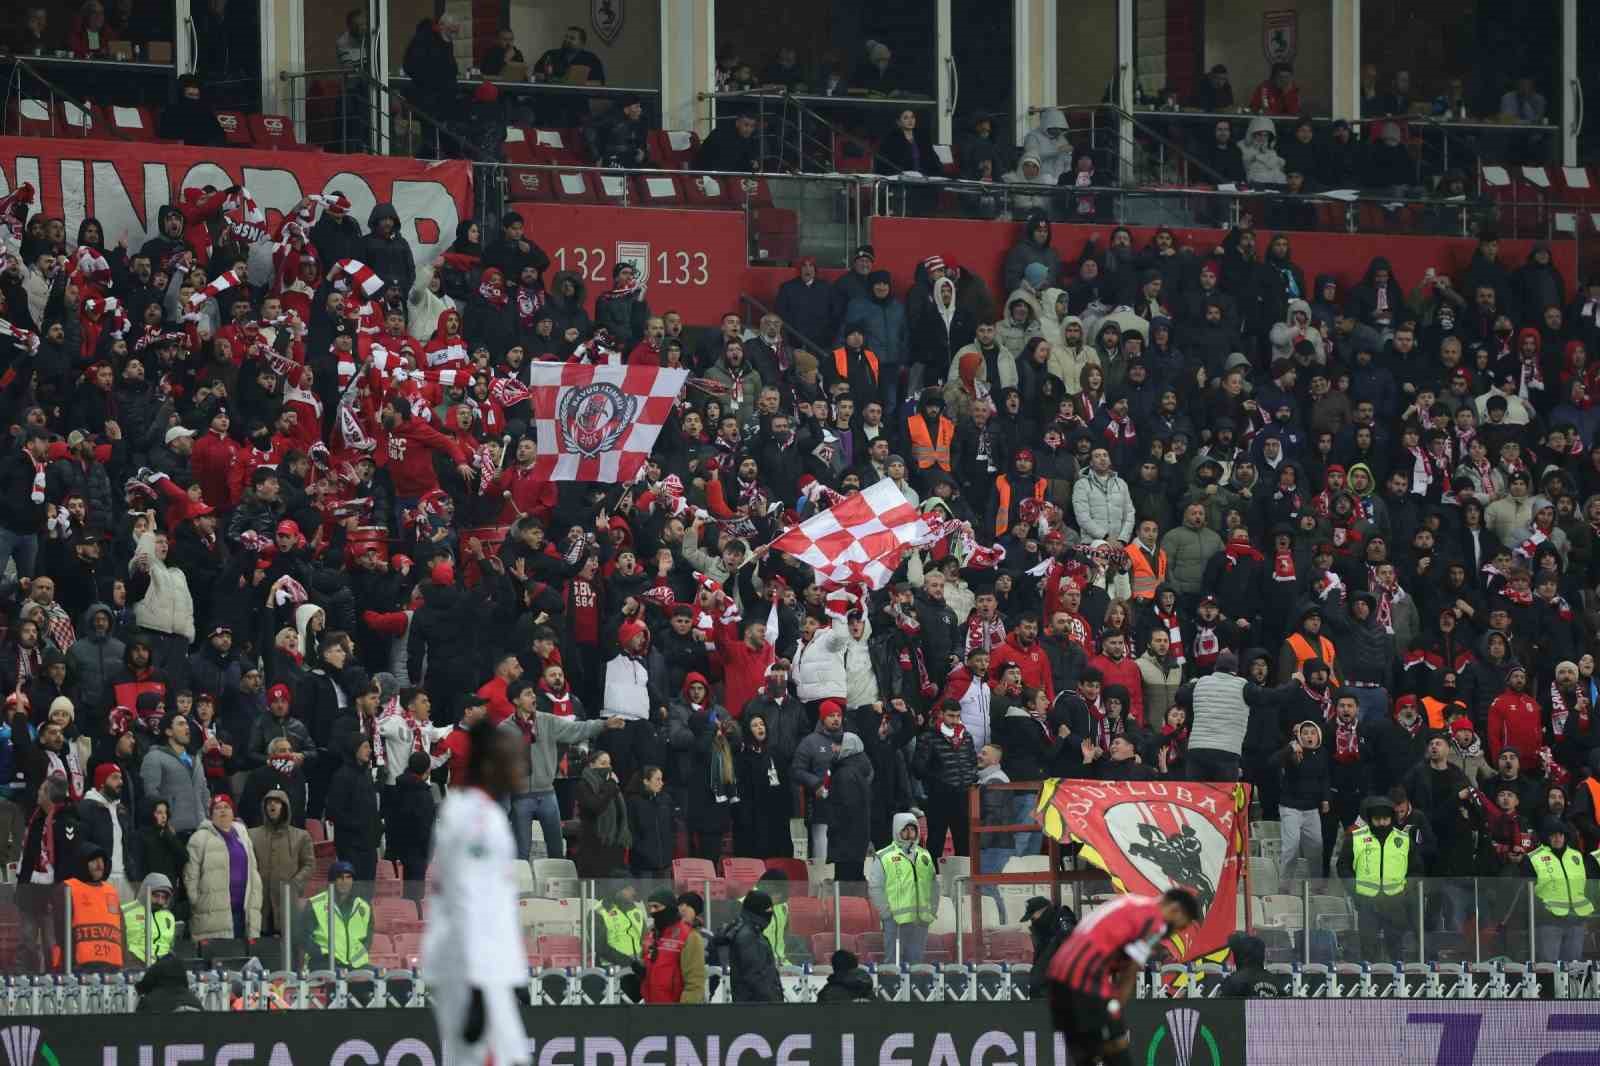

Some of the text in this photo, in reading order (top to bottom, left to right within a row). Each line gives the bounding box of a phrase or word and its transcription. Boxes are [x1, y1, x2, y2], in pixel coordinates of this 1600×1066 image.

[554, 248, 606, 281] 132
[657, 252, 709, 285] 133
[75, 925, 121, 942] STEWA
[330, 1033, 813, 1066] COERENCE
[841, 1030, 1068, 1066] LEAGU
